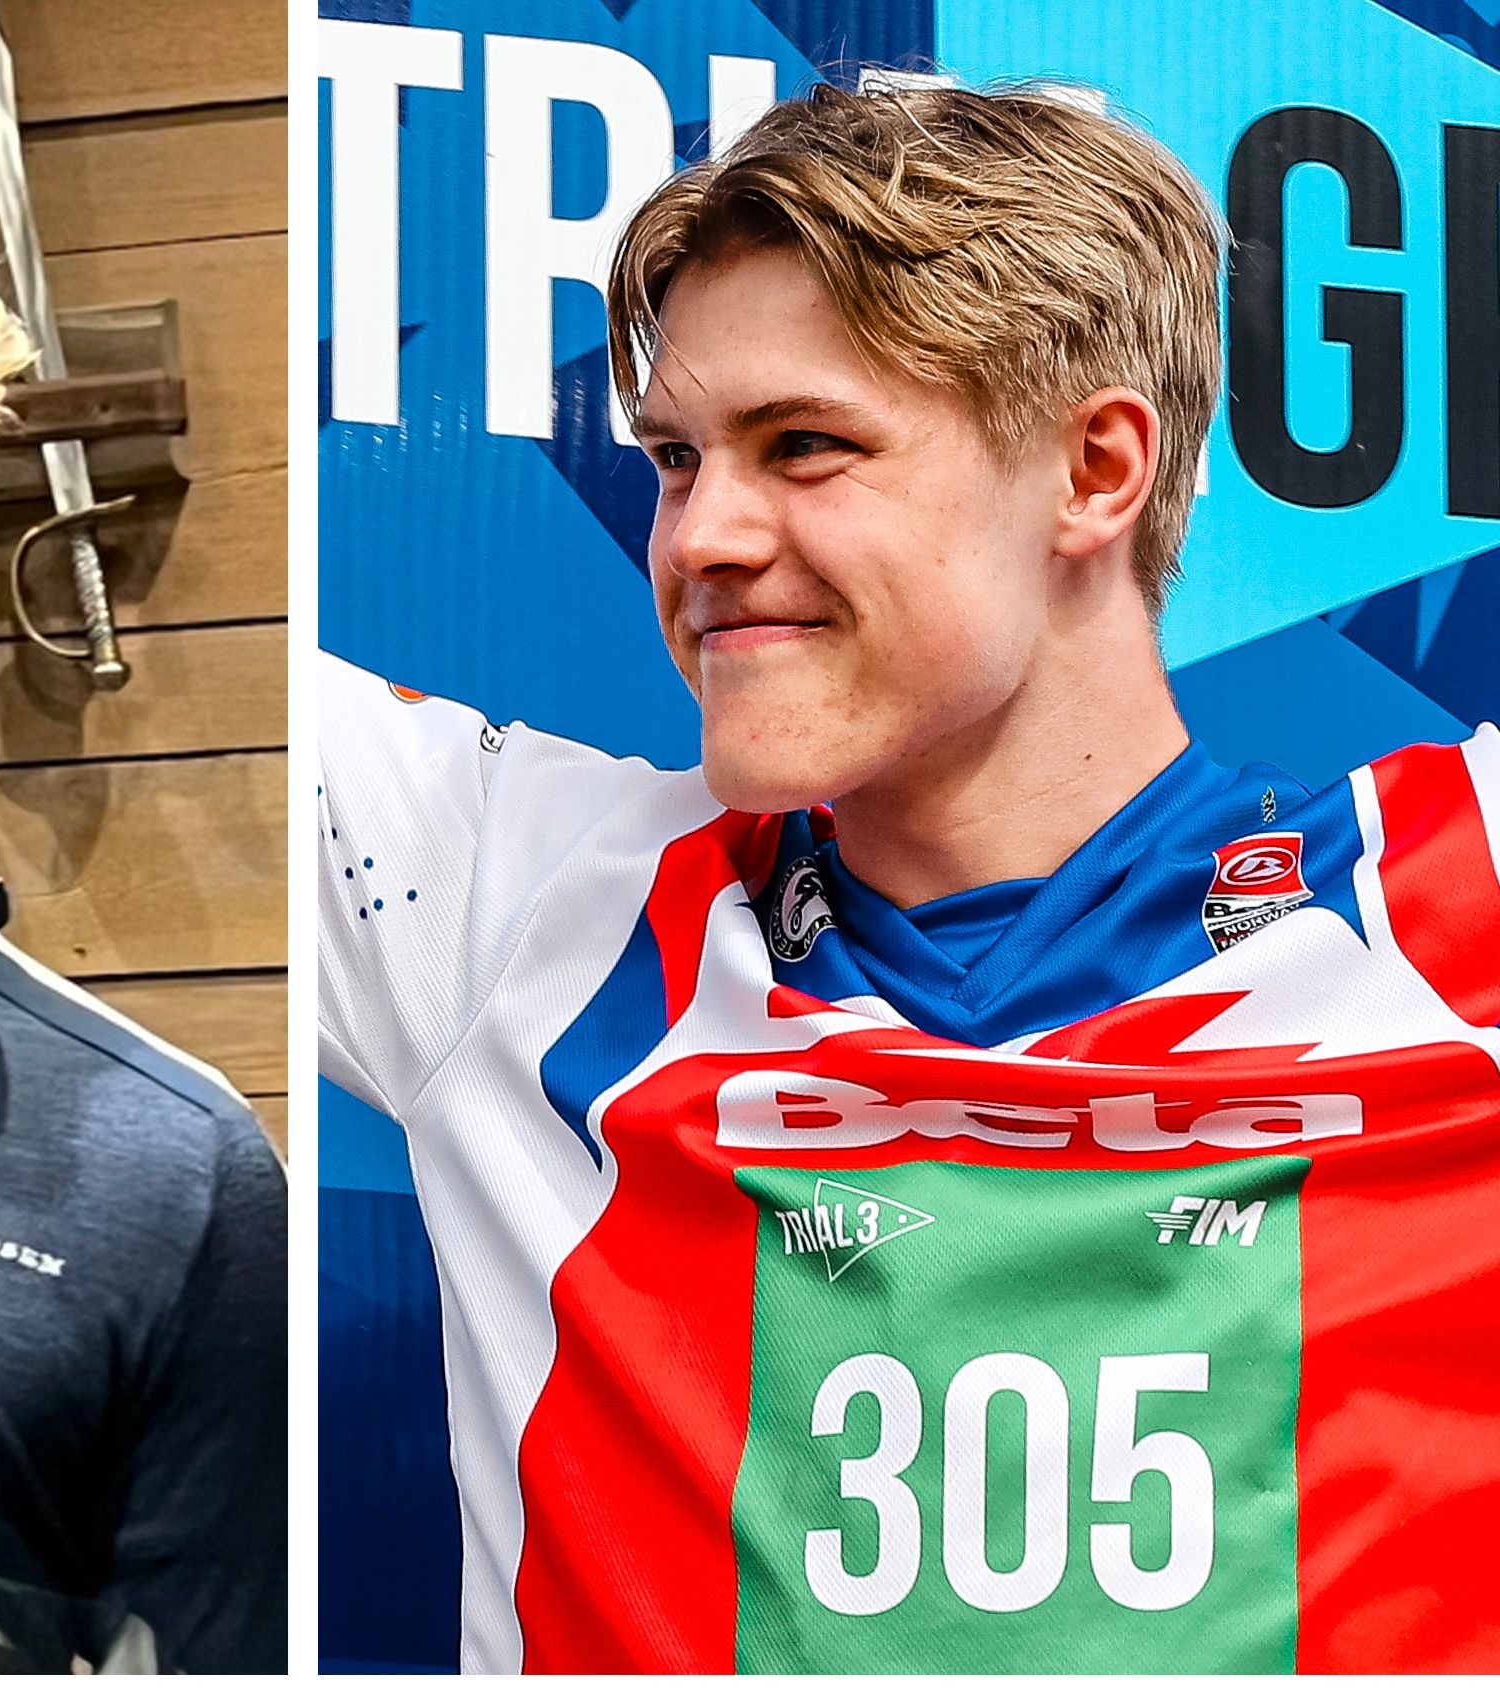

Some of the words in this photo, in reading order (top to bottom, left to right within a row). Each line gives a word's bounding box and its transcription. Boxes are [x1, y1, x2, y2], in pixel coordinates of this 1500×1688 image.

[715, 1070, 1363, 1149] Beta
[774, 1202, 855, 1255] TRIAL
[855, 1200, 881, 1245] 3
[1146, 1195, 1267, 1247] FIM
[802, 1352, 1216, 1617] 305
